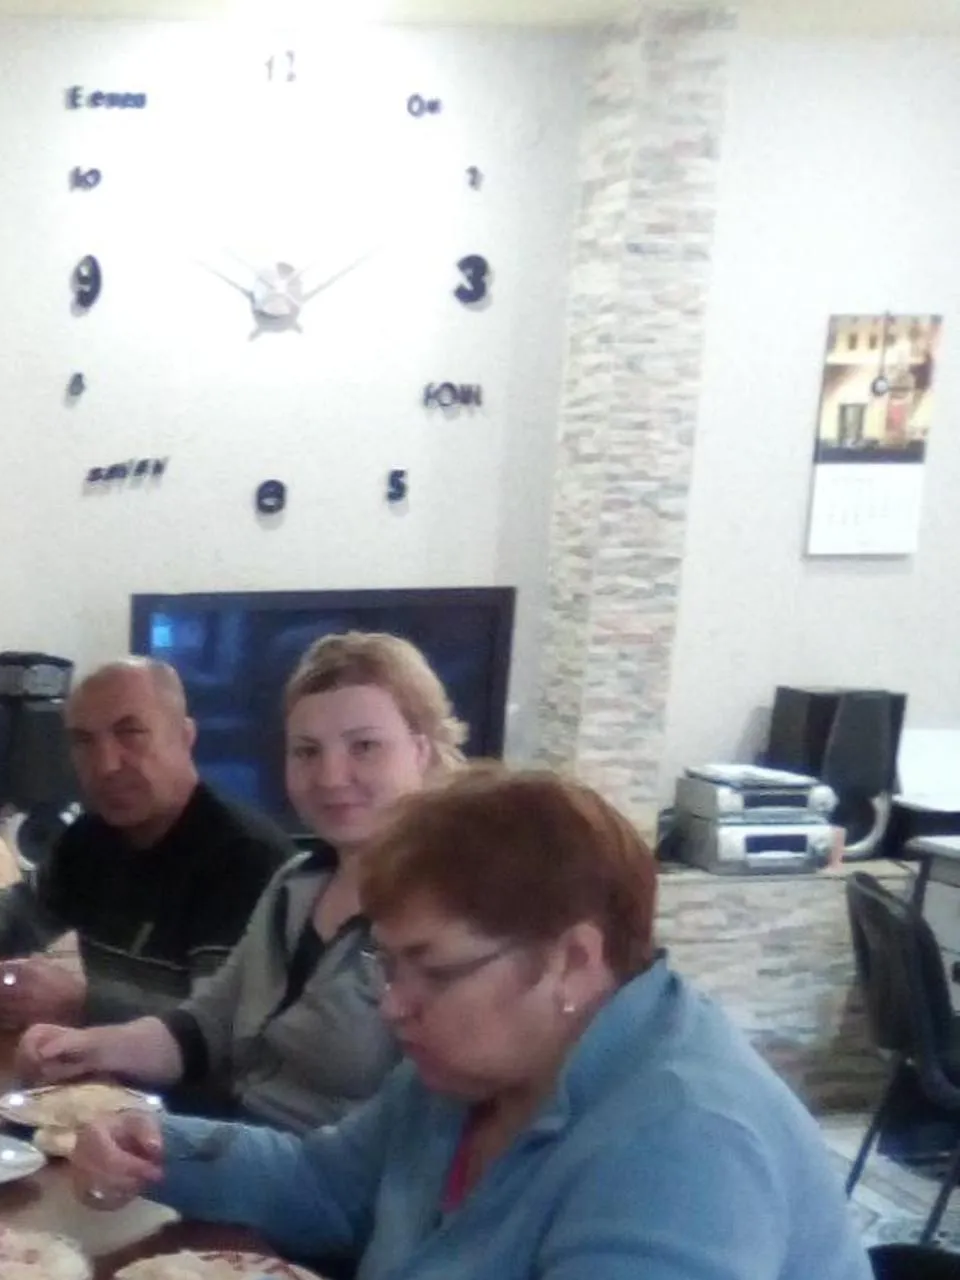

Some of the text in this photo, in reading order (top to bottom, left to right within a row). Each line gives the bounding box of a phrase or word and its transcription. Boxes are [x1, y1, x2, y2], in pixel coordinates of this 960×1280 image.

[74, 255, 102, 299] 9
[455, 256, 489, 303] 3
[386, 469, 408, 503] 5
